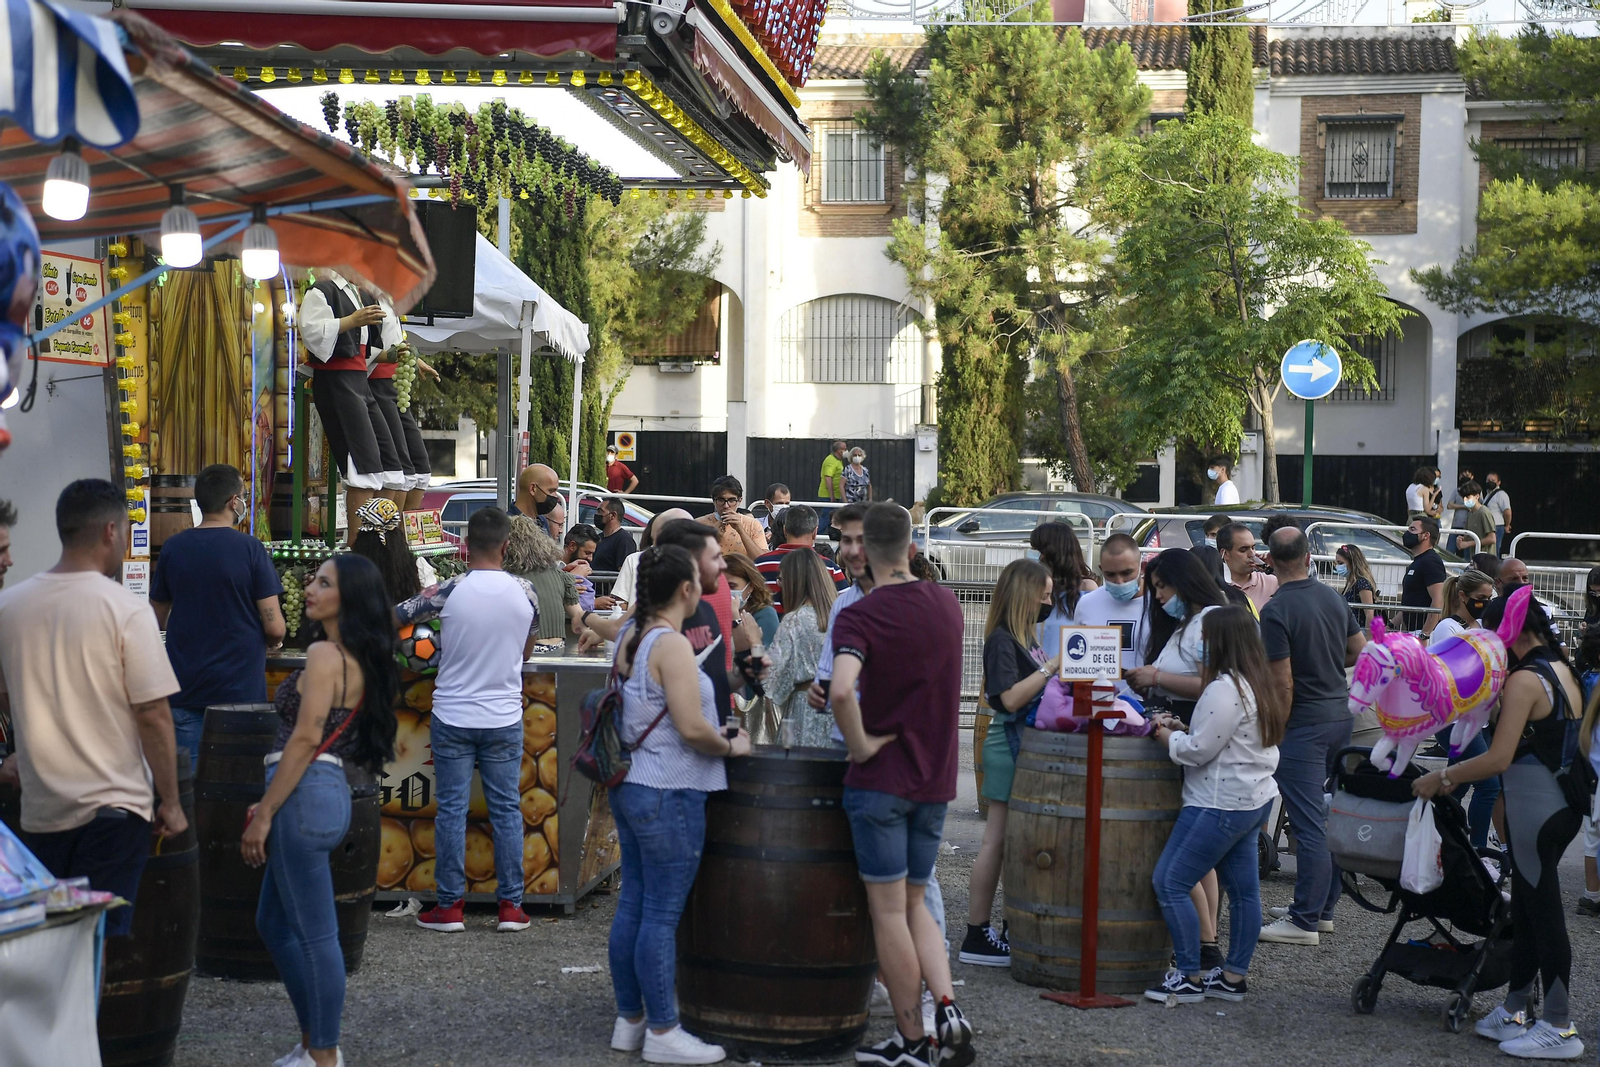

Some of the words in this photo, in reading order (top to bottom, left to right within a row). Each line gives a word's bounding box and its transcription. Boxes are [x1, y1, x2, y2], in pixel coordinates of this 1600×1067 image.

[685, 625, 714, 650] NIKE
[1093, 654, 1101, 663] DE
[1104, 654, 1116, 663] GEL
